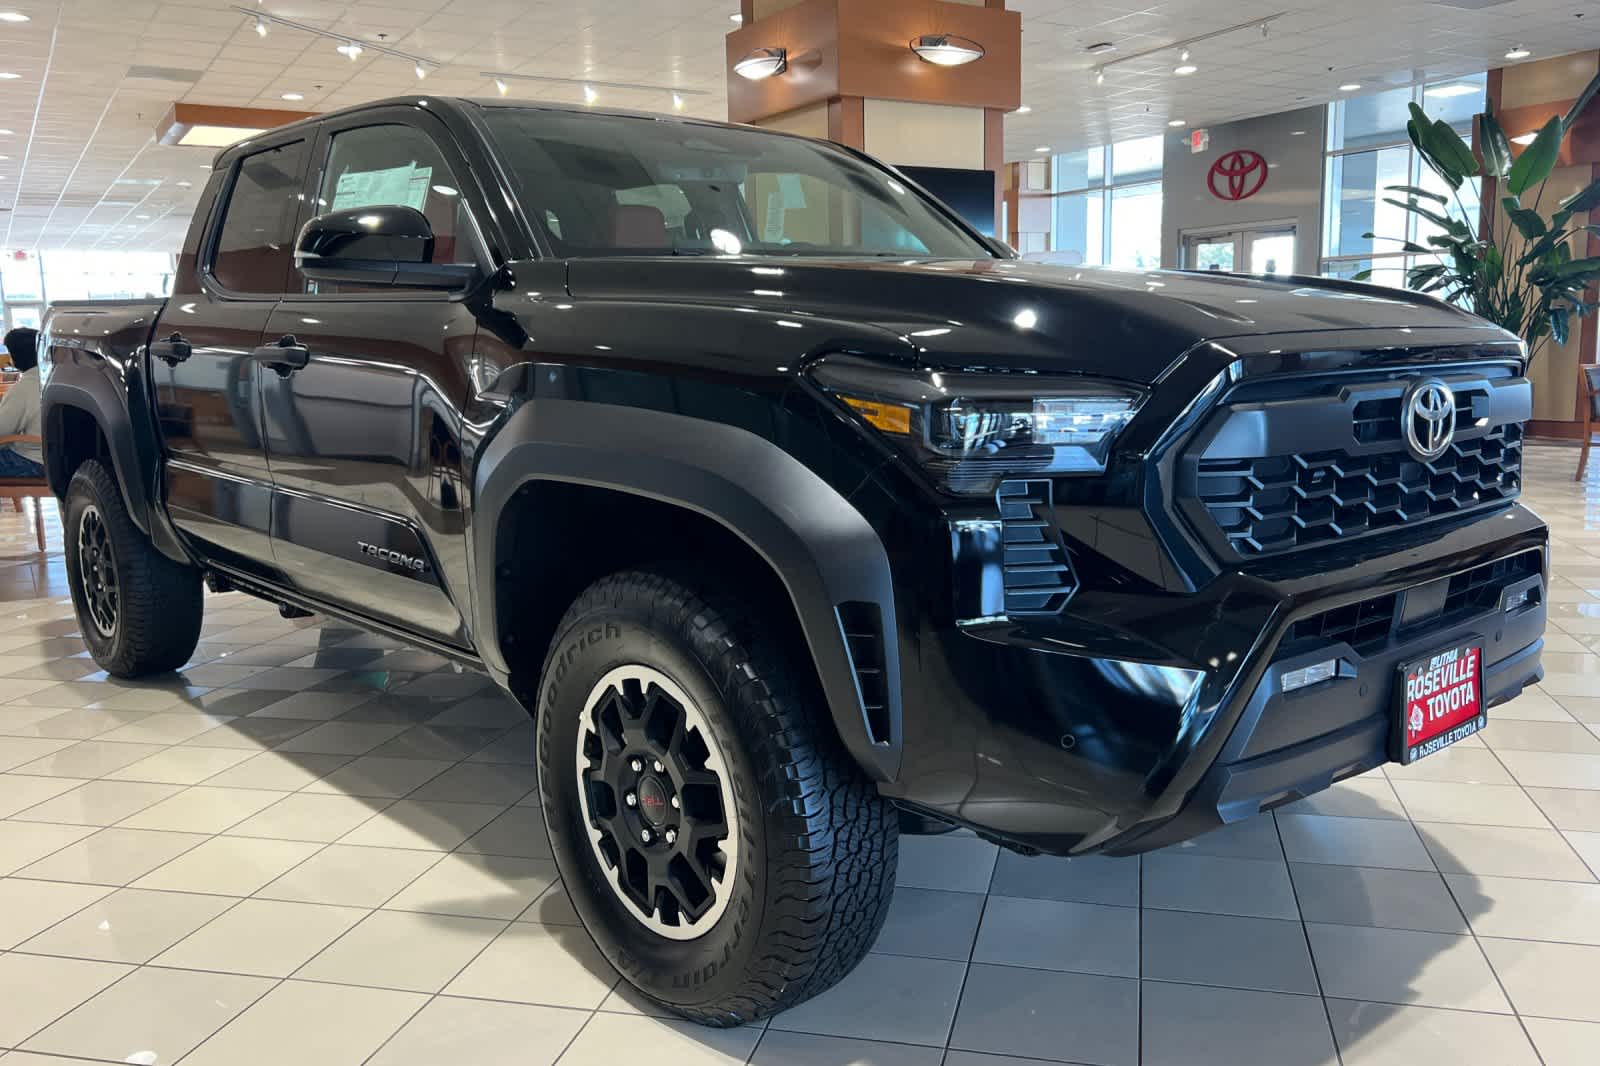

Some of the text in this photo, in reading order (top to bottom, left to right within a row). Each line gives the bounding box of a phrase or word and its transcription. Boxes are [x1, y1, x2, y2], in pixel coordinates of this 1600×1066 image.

[357, 541, 425, 572] TACOMA
[1407, 655, 1475, 702] ROSEVILLE
[1426, 681, 1475, 721] TOYOTA
[1419, 721, 1477, 759] ROSEVILLE TOYOTA
